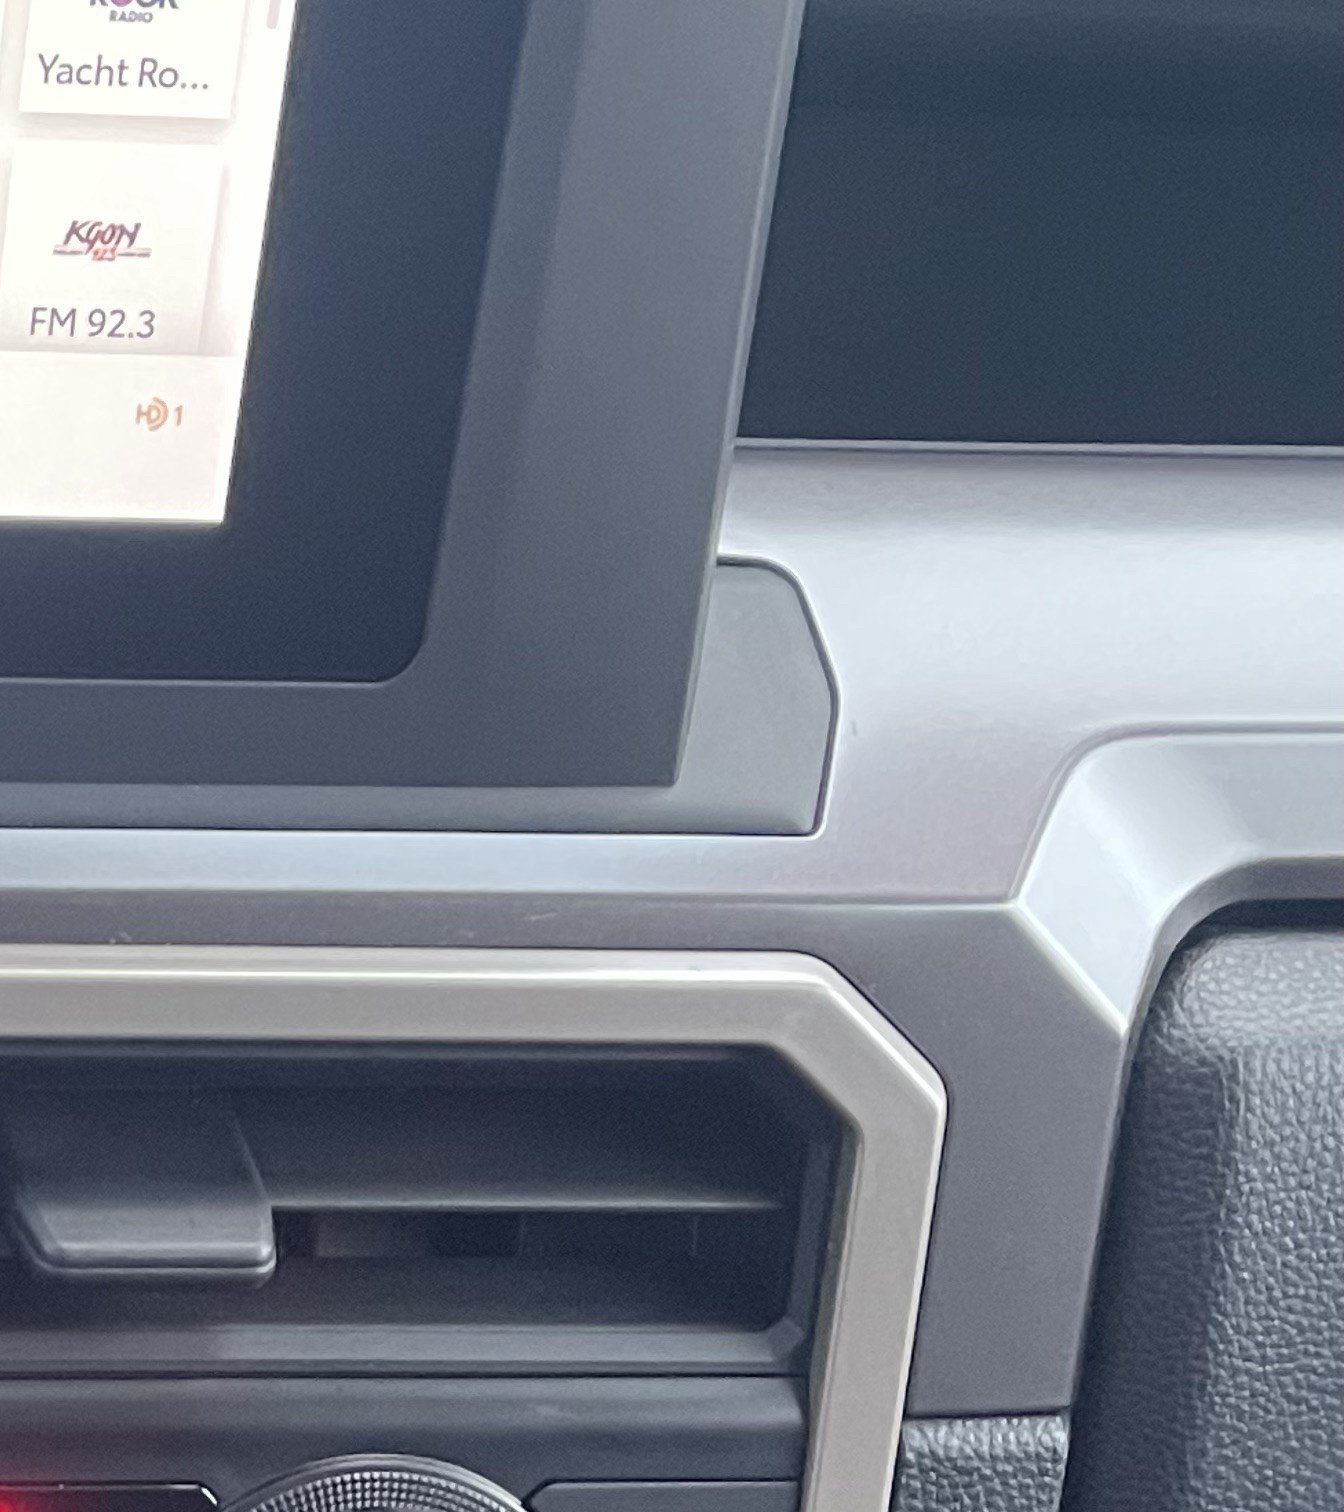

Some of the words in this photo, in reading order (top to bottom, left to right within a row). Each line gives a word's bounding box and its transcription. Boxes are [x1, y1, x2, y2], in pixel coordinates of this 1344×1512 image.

[38, 53, 130, 87] Yacht
[30, 306, 77, 338] FM
[88, 308, 156, 339] 92.3
